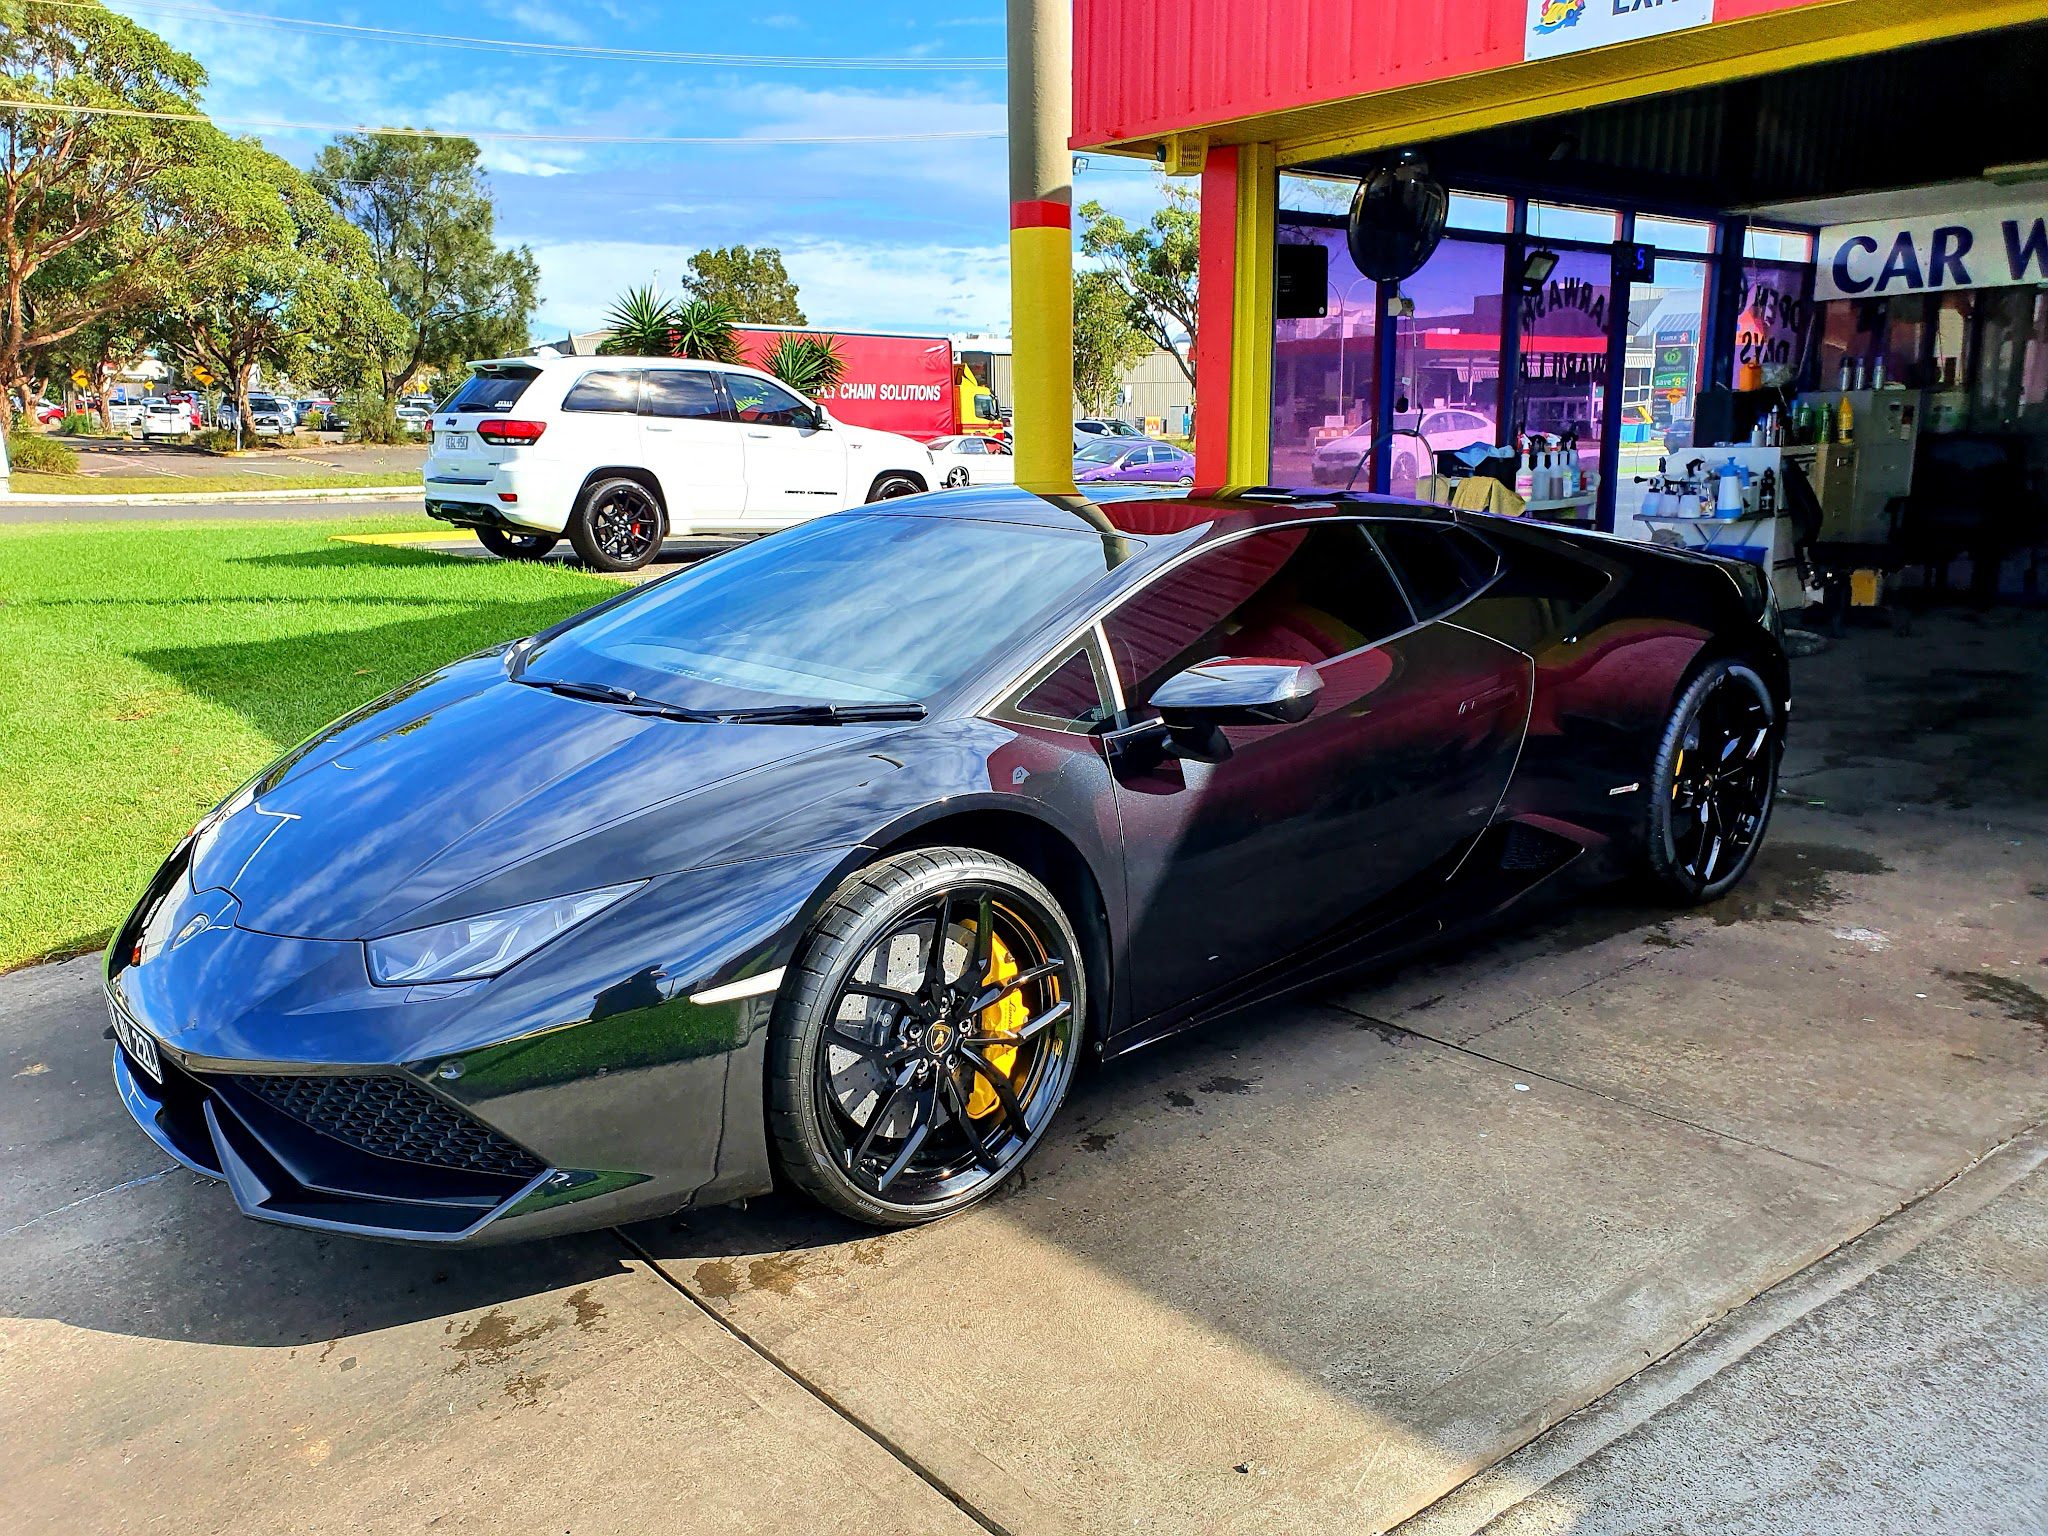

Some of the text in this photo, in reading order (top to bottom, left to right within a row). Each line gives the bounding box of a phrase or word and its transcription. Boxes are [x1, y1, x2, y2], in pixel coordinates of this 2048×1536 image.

[1832, 226, 1974, 294] CAR
[841, 383, 876, 399] CHAIN
[879, 384, 941, 401] SOLUTIONS
